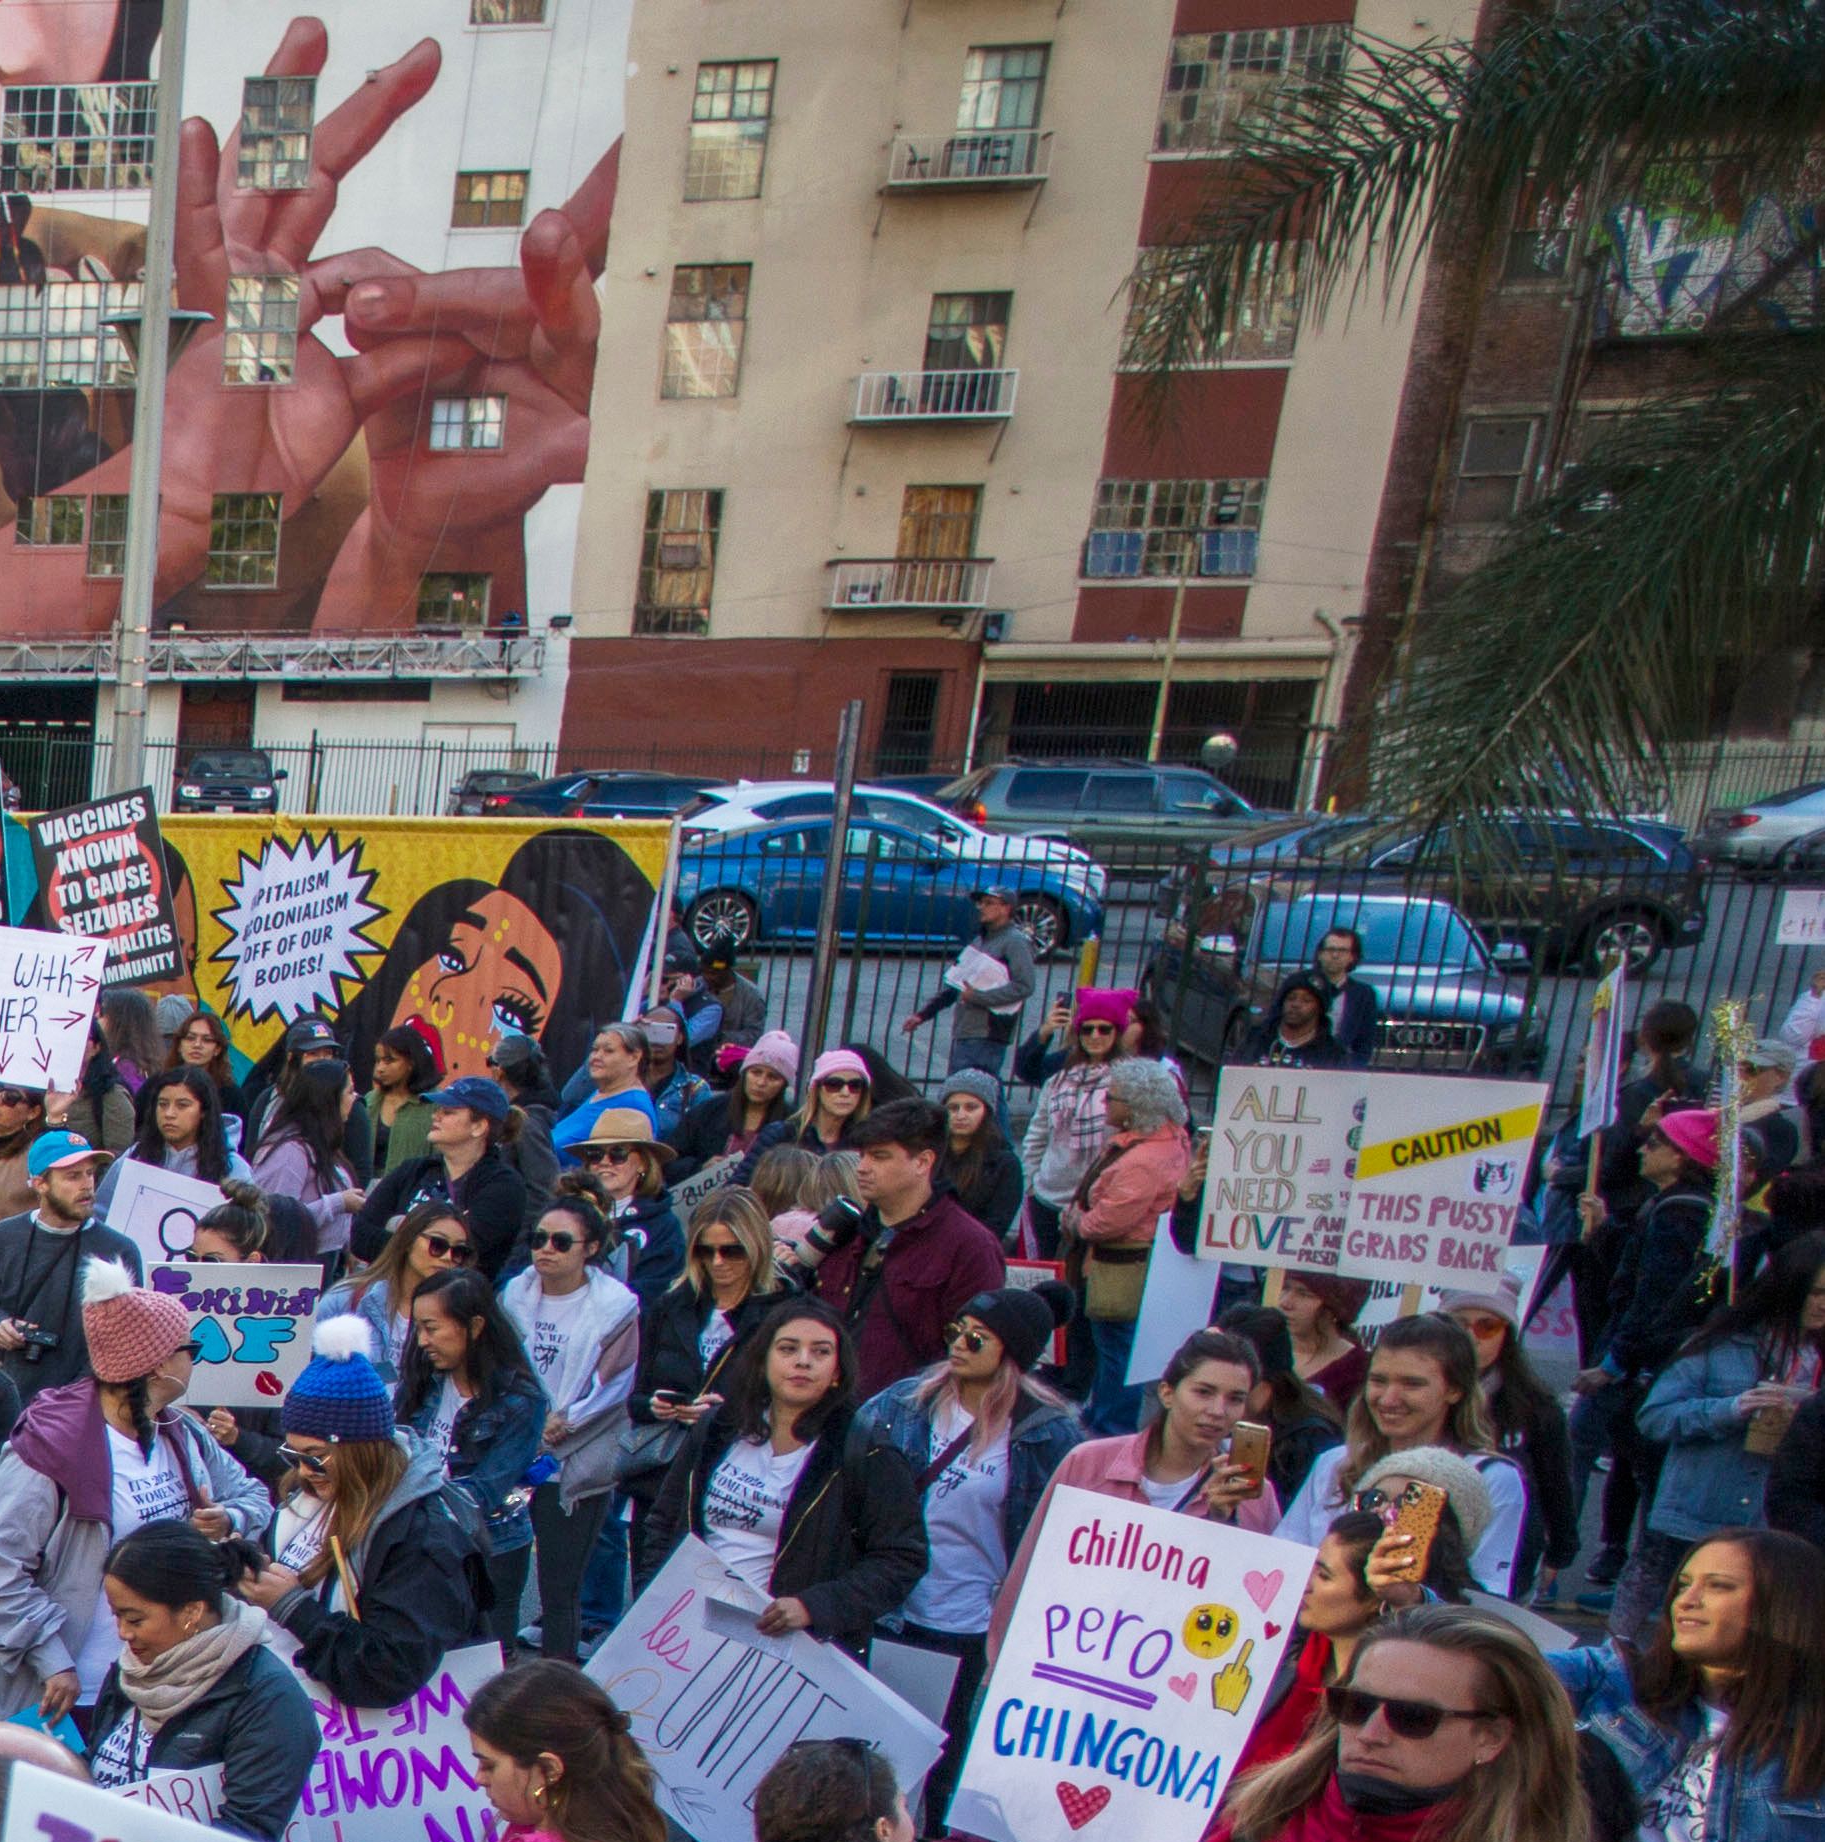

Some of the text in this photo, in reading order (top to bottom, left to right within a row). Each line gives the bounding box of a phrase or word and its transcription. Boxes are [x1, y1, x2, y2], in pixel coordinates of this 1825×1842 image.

[37, 796, 148, 847] VACCINES
[56, 831, 139, 877] KNOWN
[55, 863, 153, 908] TO CAUSE
[57, 894, 160, 938] SEIZURES
[244, 925, 333, 965] OFF OF OUR
[14, 952, 74, 997] With
[254, 953, 324, 988] BODIES!
[1228, 1085, 1322, 1124] ALL
[1223, 1129, 1302, 1178] YOU
[1390, 1118, 1503, 1168] CAUTION
[1215, 1177, 1297, 1214] NEED
[1358, 1192, 1520, 1236] THIS PUSSY
[1204, 1212, 1305, 1256] LOVE
[1348, 1229, 1503, 1272] GRABS BACK
[1067, 1517, 1210, 1591] chillona
[1044, 1602, 1172, 1680] pero
[994, 1697, 1217, 1810] CHINGONA
